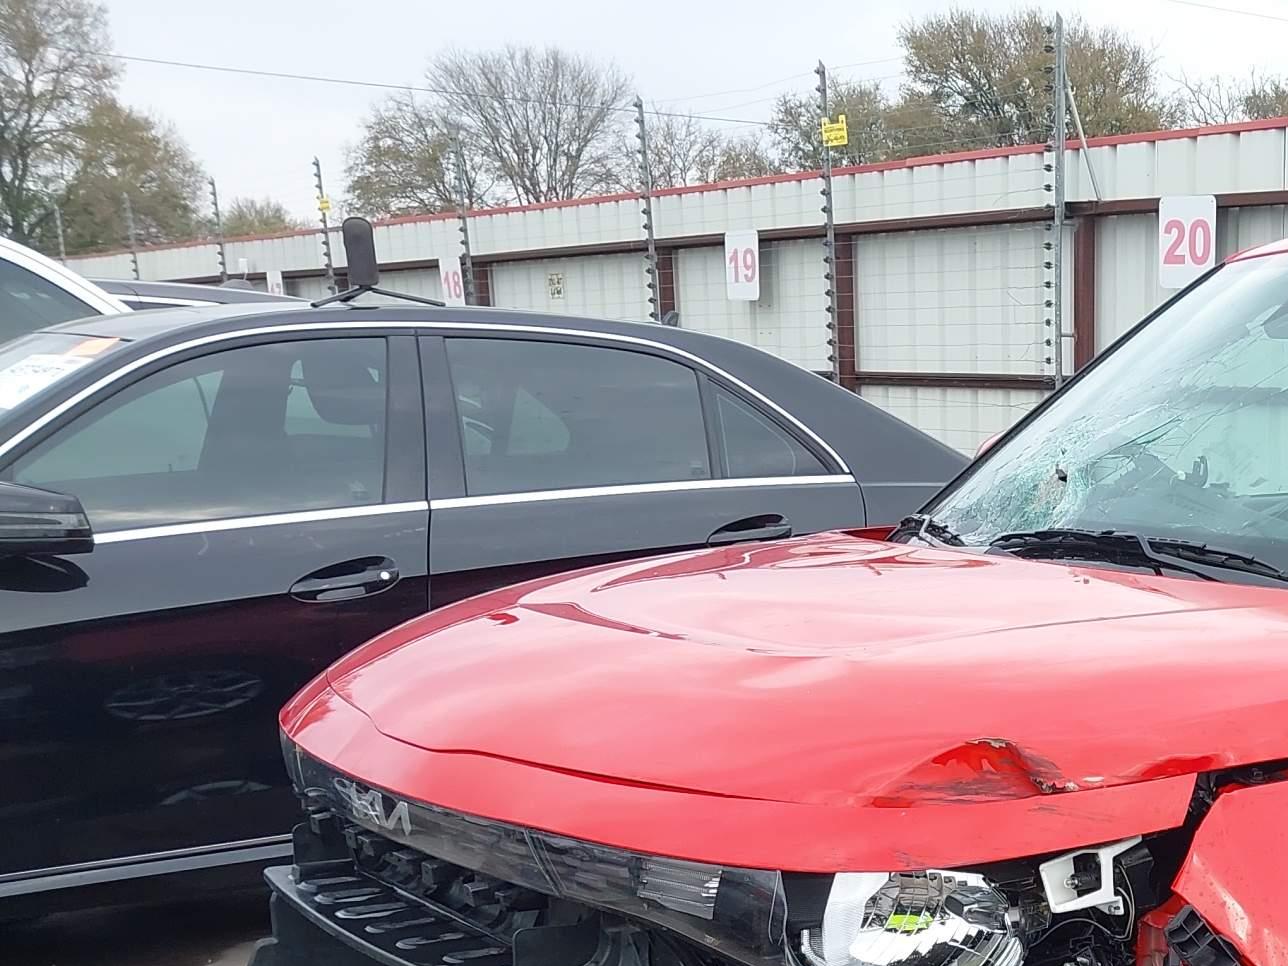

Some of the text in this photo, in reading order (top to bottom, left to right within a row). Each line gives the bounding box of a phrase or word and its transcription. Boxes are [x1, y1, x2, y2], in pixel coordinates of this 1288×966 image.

[1163, 218, 1212, 266] 20
[729, 247, 756, 283] 19
[443, 271, 462, 299] 18
